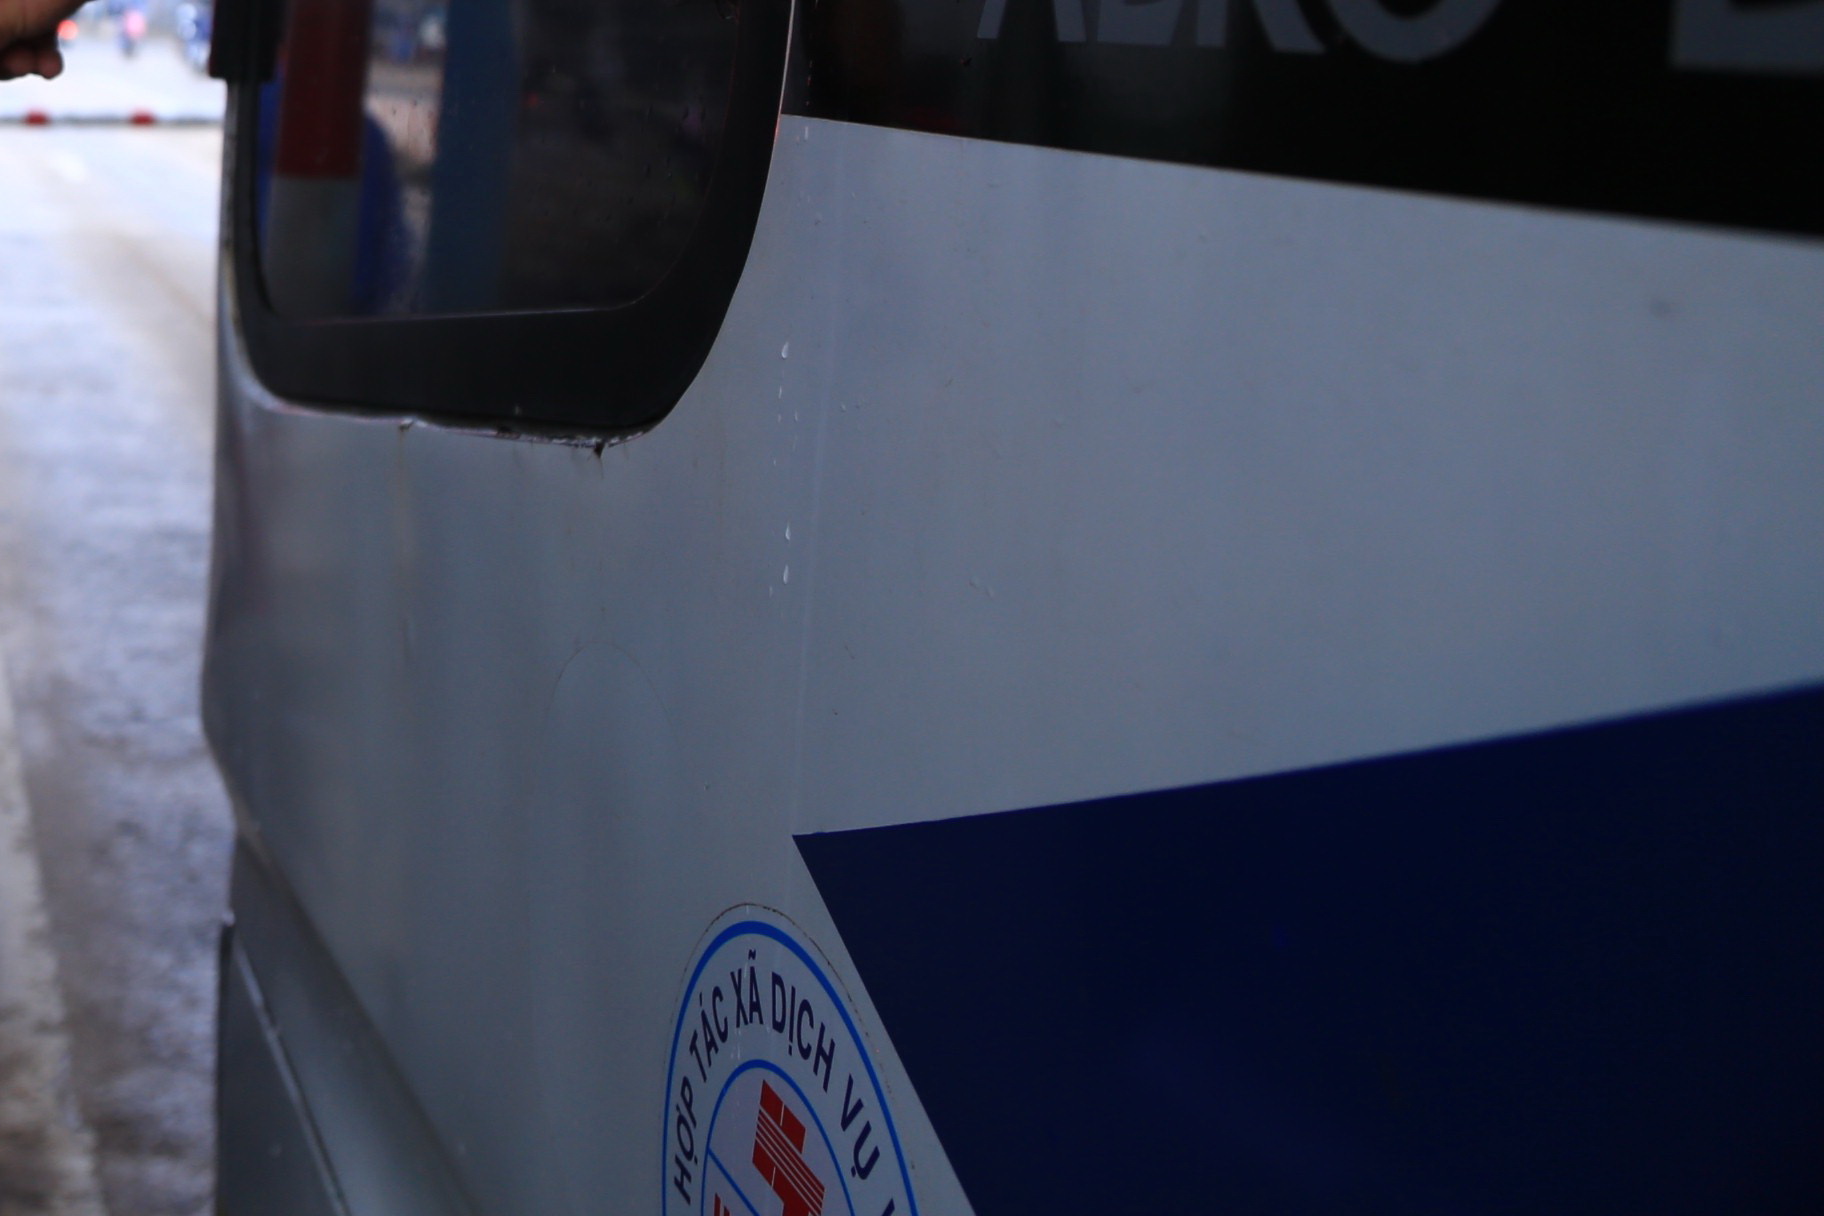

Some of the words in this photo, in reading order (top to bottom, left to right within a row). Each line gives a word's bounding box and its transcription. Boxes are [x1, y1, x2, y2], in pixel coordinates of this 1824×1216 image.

[673, 1076, 698, 1205] HỢP
[689, 986, 729, 1083] TÁC
[730, 949, 764, 1028] XÃ
[771, 972, 836, 1093] DỊCH
[840, 1074, 880, 1181] VỤ
